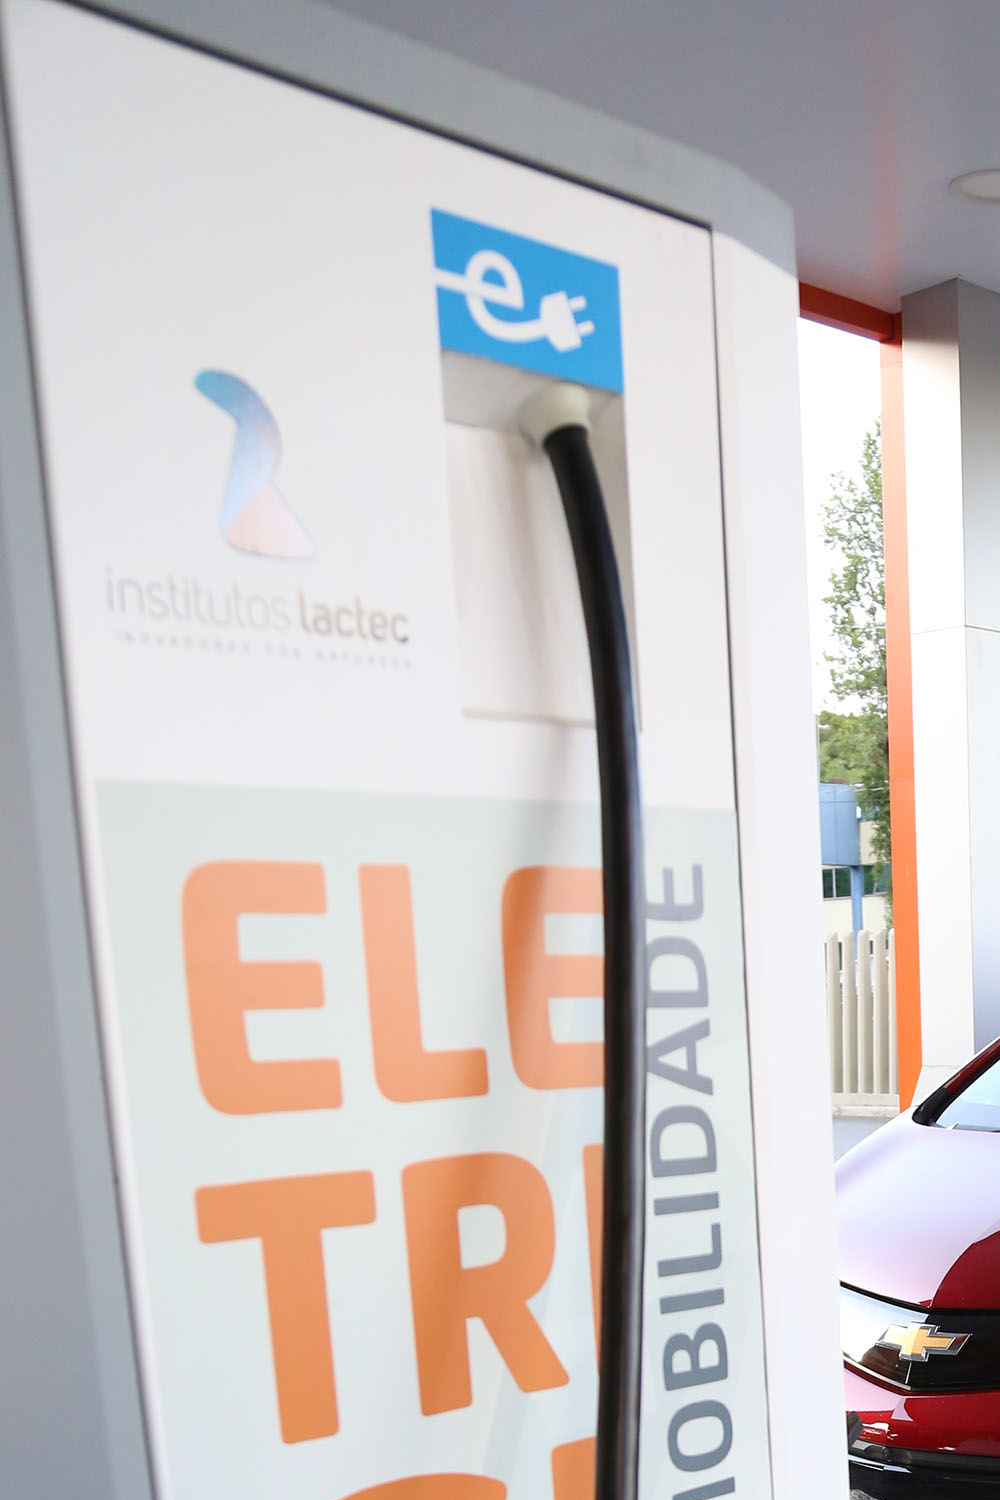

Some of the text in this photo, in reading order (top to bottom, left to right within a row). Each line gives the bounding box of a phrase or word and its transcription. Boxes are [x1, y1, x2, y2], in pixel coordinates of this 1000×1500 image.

[104, 565, 411, 645] institutos lactec
[181, 860, 604, 1116] ELE
[194, 1142, 604, 1446] TR
